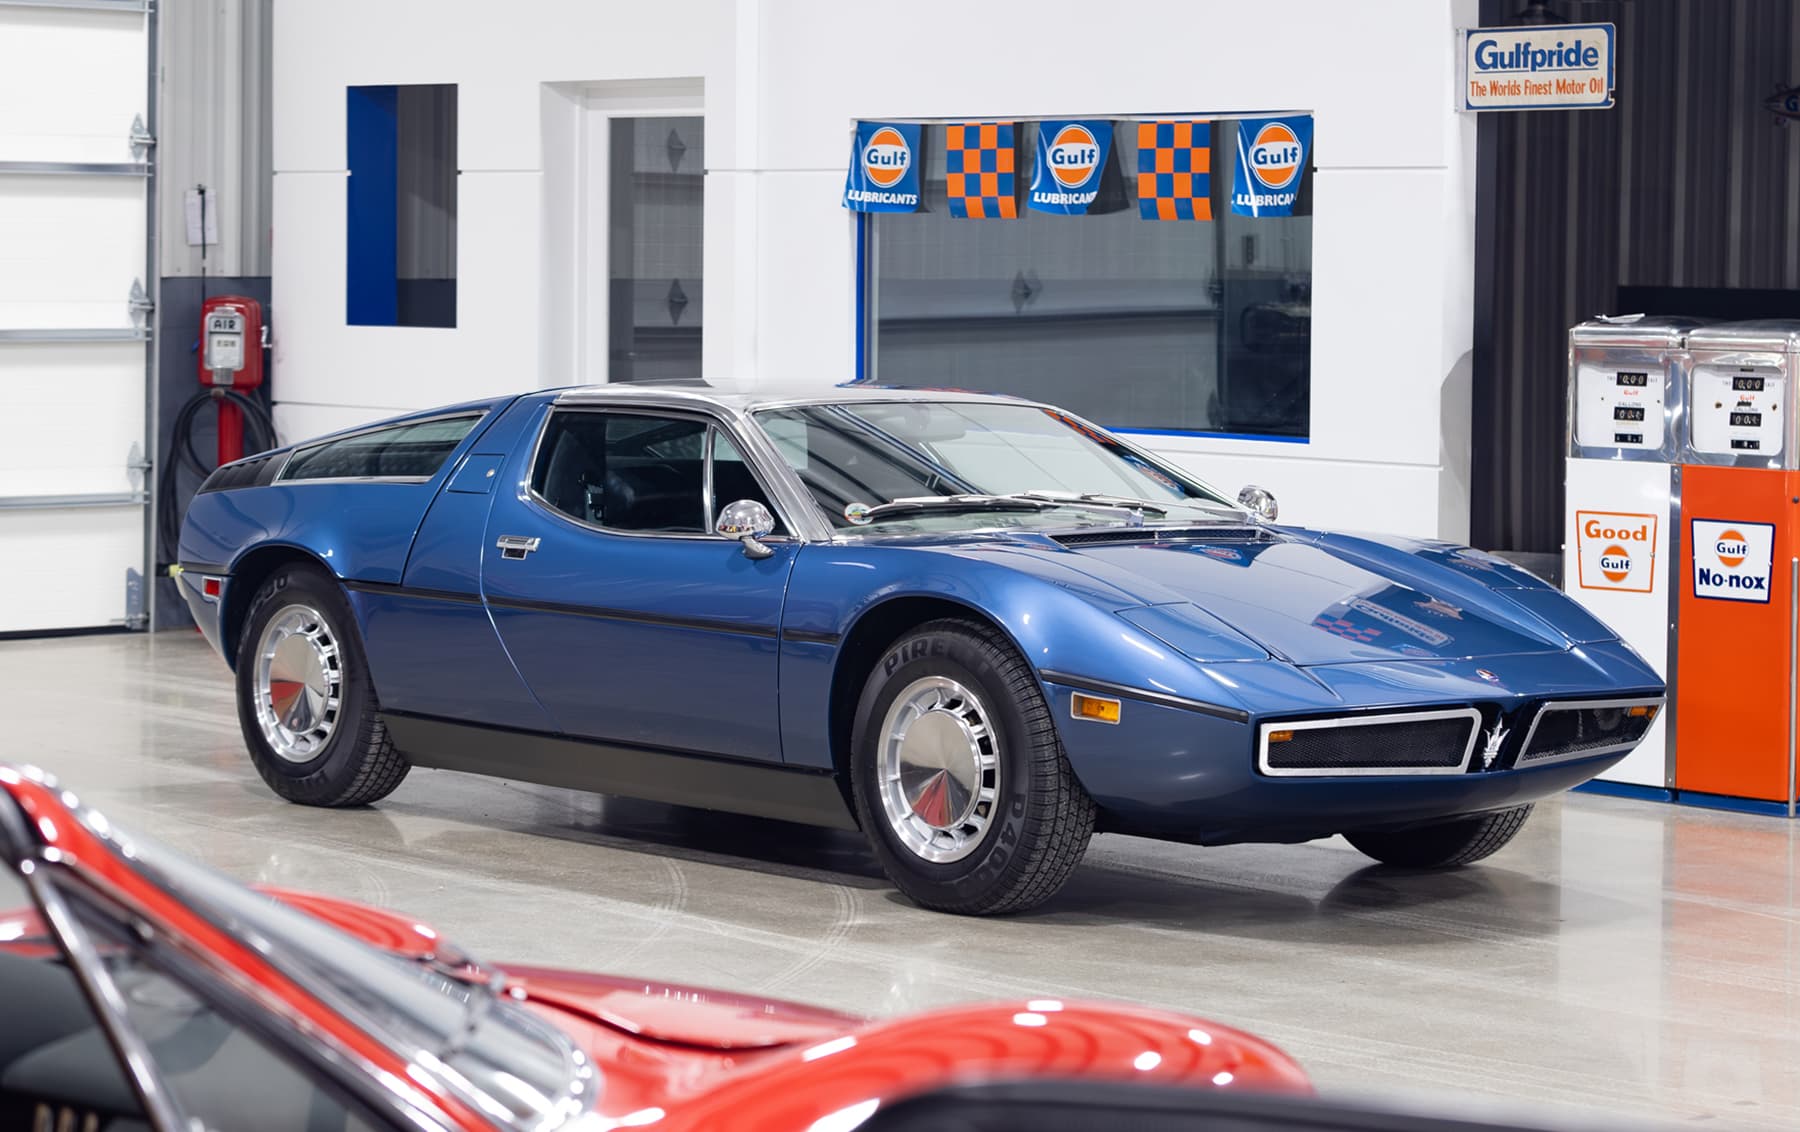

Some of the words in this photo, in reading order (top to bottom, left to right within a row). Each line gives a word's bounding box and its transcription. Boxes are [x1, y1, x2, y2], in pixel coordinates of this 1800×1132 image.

[1474, 39, 1599, 72] Gulfpride
[1470, 80, 1487, 96] The
[1489, 79, 1521, 96] Worlds
[1524, 79, 1552, 96] Finest
[1555, 78, 1585, 95] Motor
[1588, 77, 1604, 94] Oil
[866, 148, 907, 166] Gulf
[1051, 148, 1096, 165] Gulf
[1253, 147, 1298, 165] Gulf
[848, 189, 918, 205] LUBRICANTS
[214, 319, 236, 330] AIR
[1584, 520, 1647, 542] Good
[1716, 542, 1748, 556] Gulf
[1600, 557, 1631, 571] Gulf
